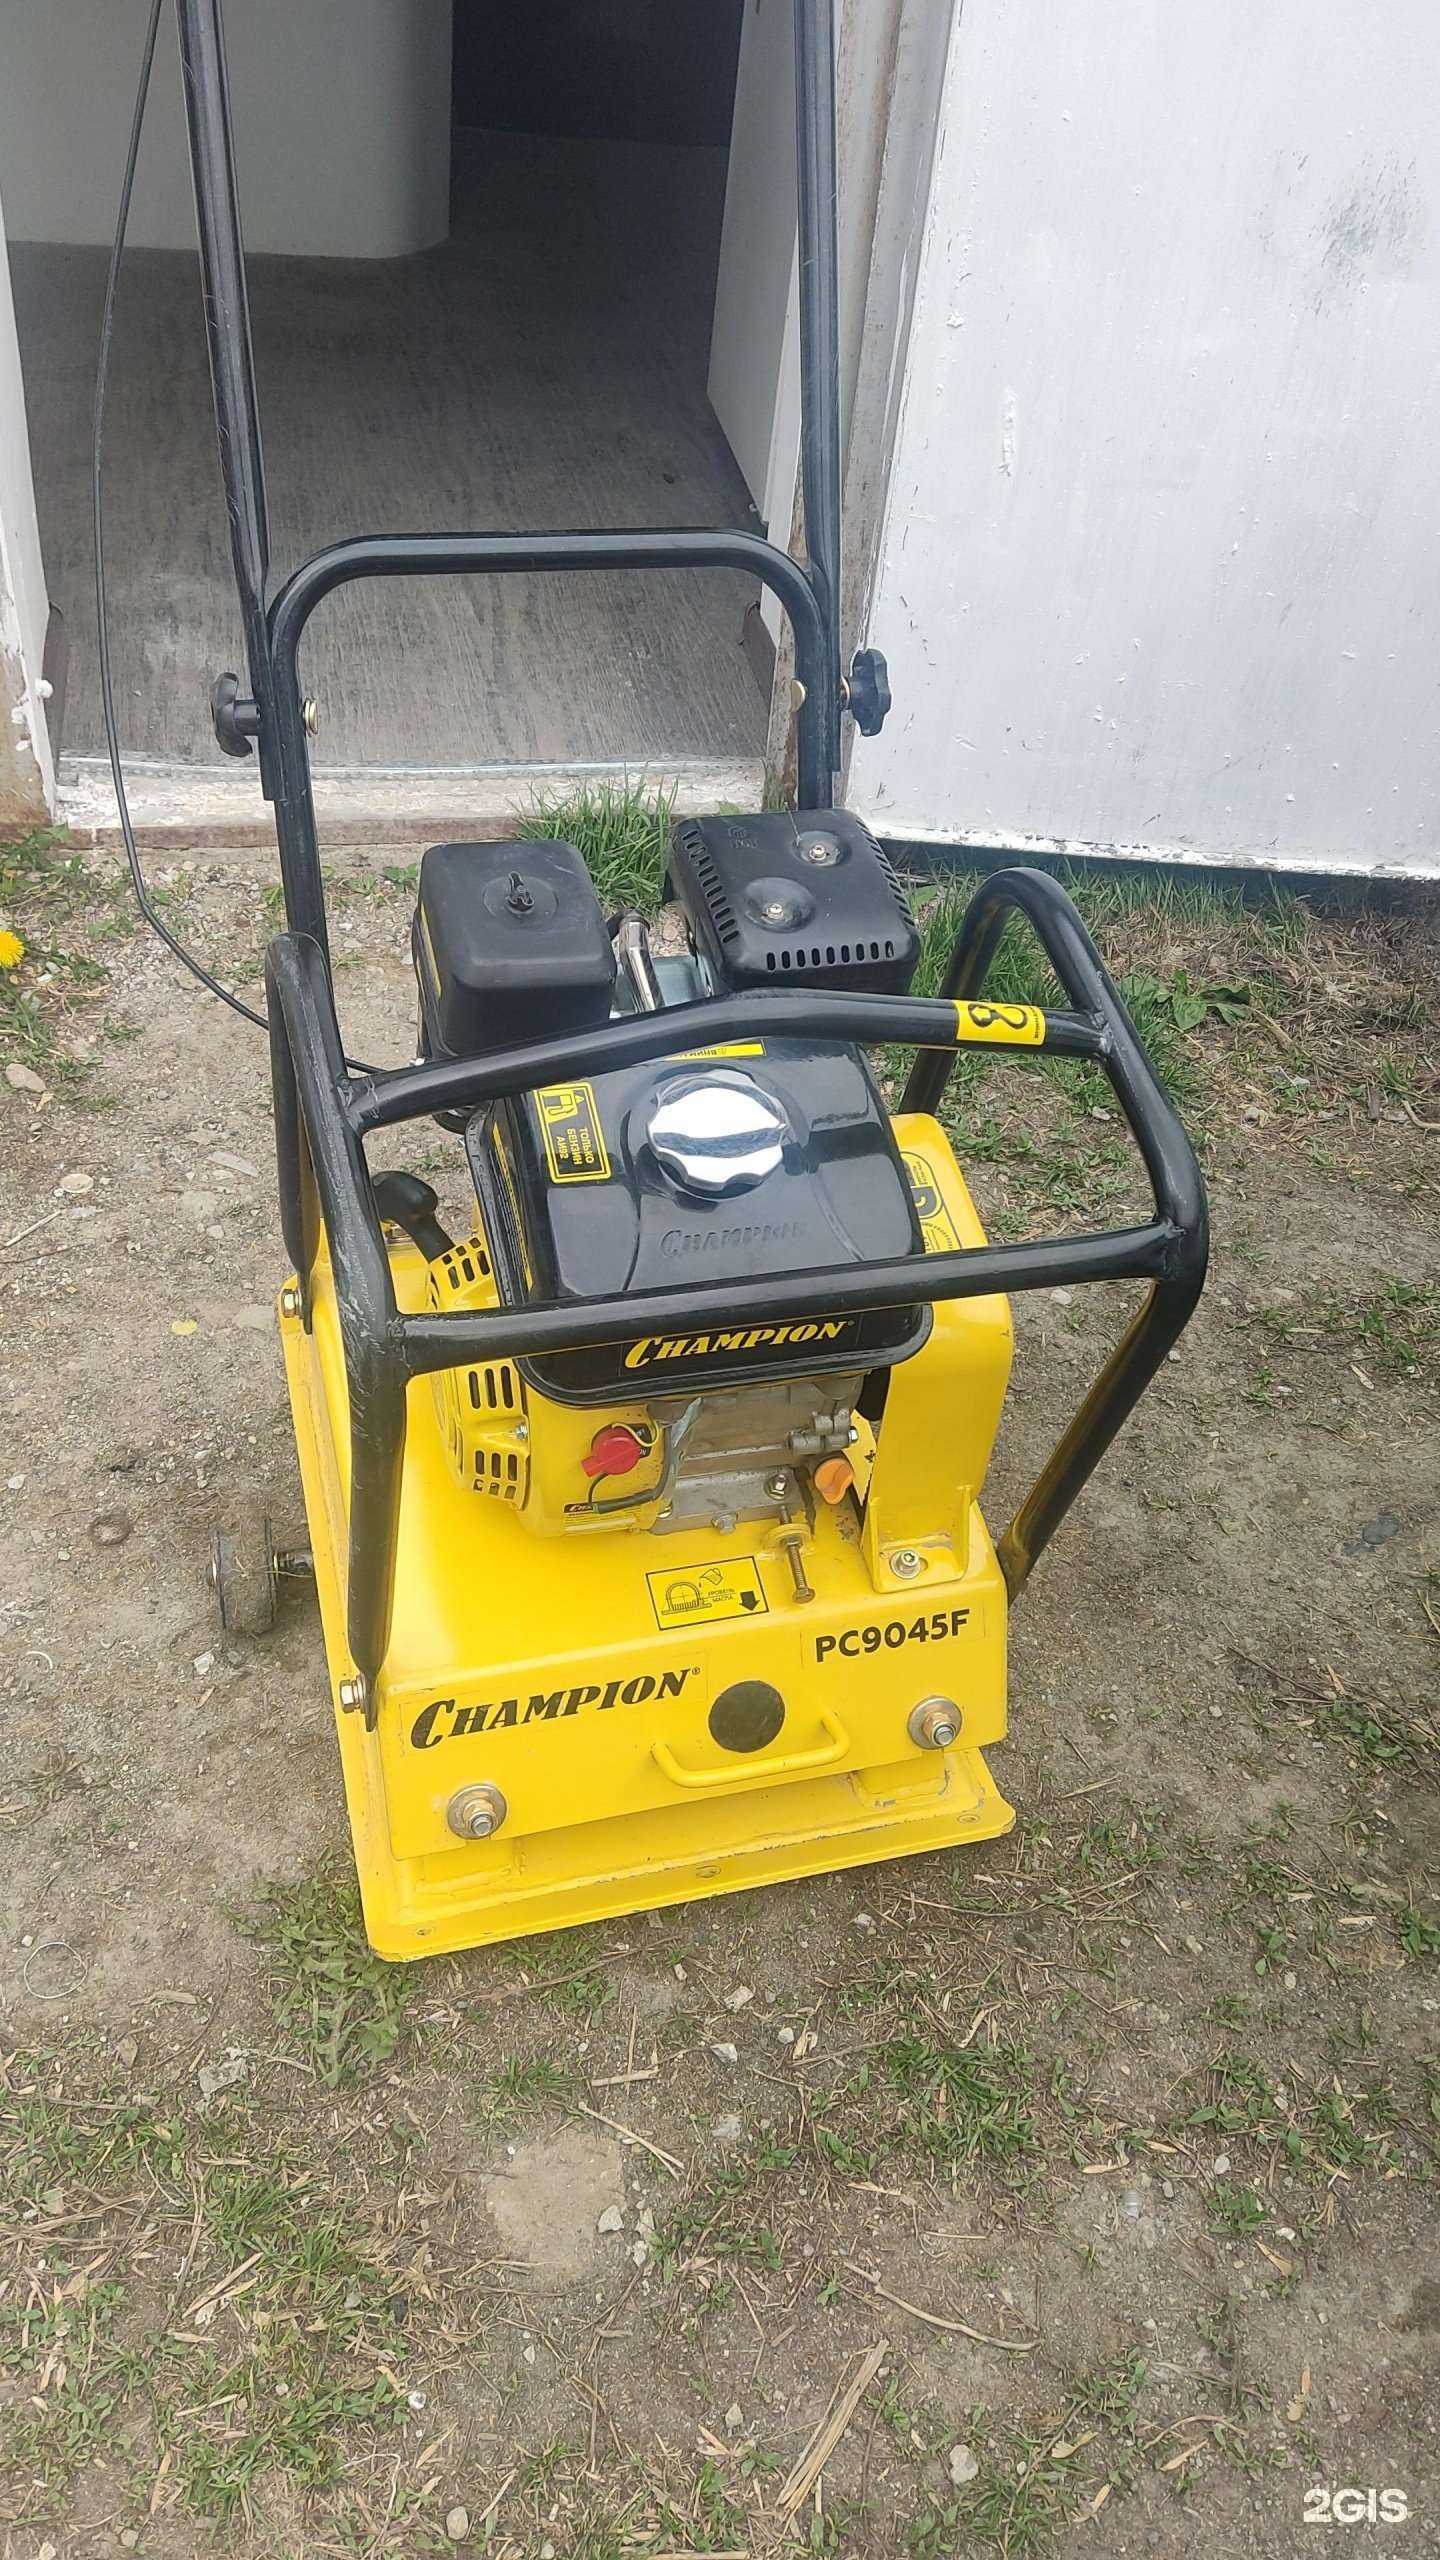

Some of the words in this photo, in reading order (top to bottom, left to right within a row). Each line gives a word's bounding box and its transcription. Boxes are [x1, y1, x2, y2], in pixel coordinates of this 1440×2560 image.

[567, 1128, 583, 1165] БЕНЗИН
[579, 1126, 595, 1164] ТОЛЬКО
[815, 1608, 970, 1663] PC9045F
